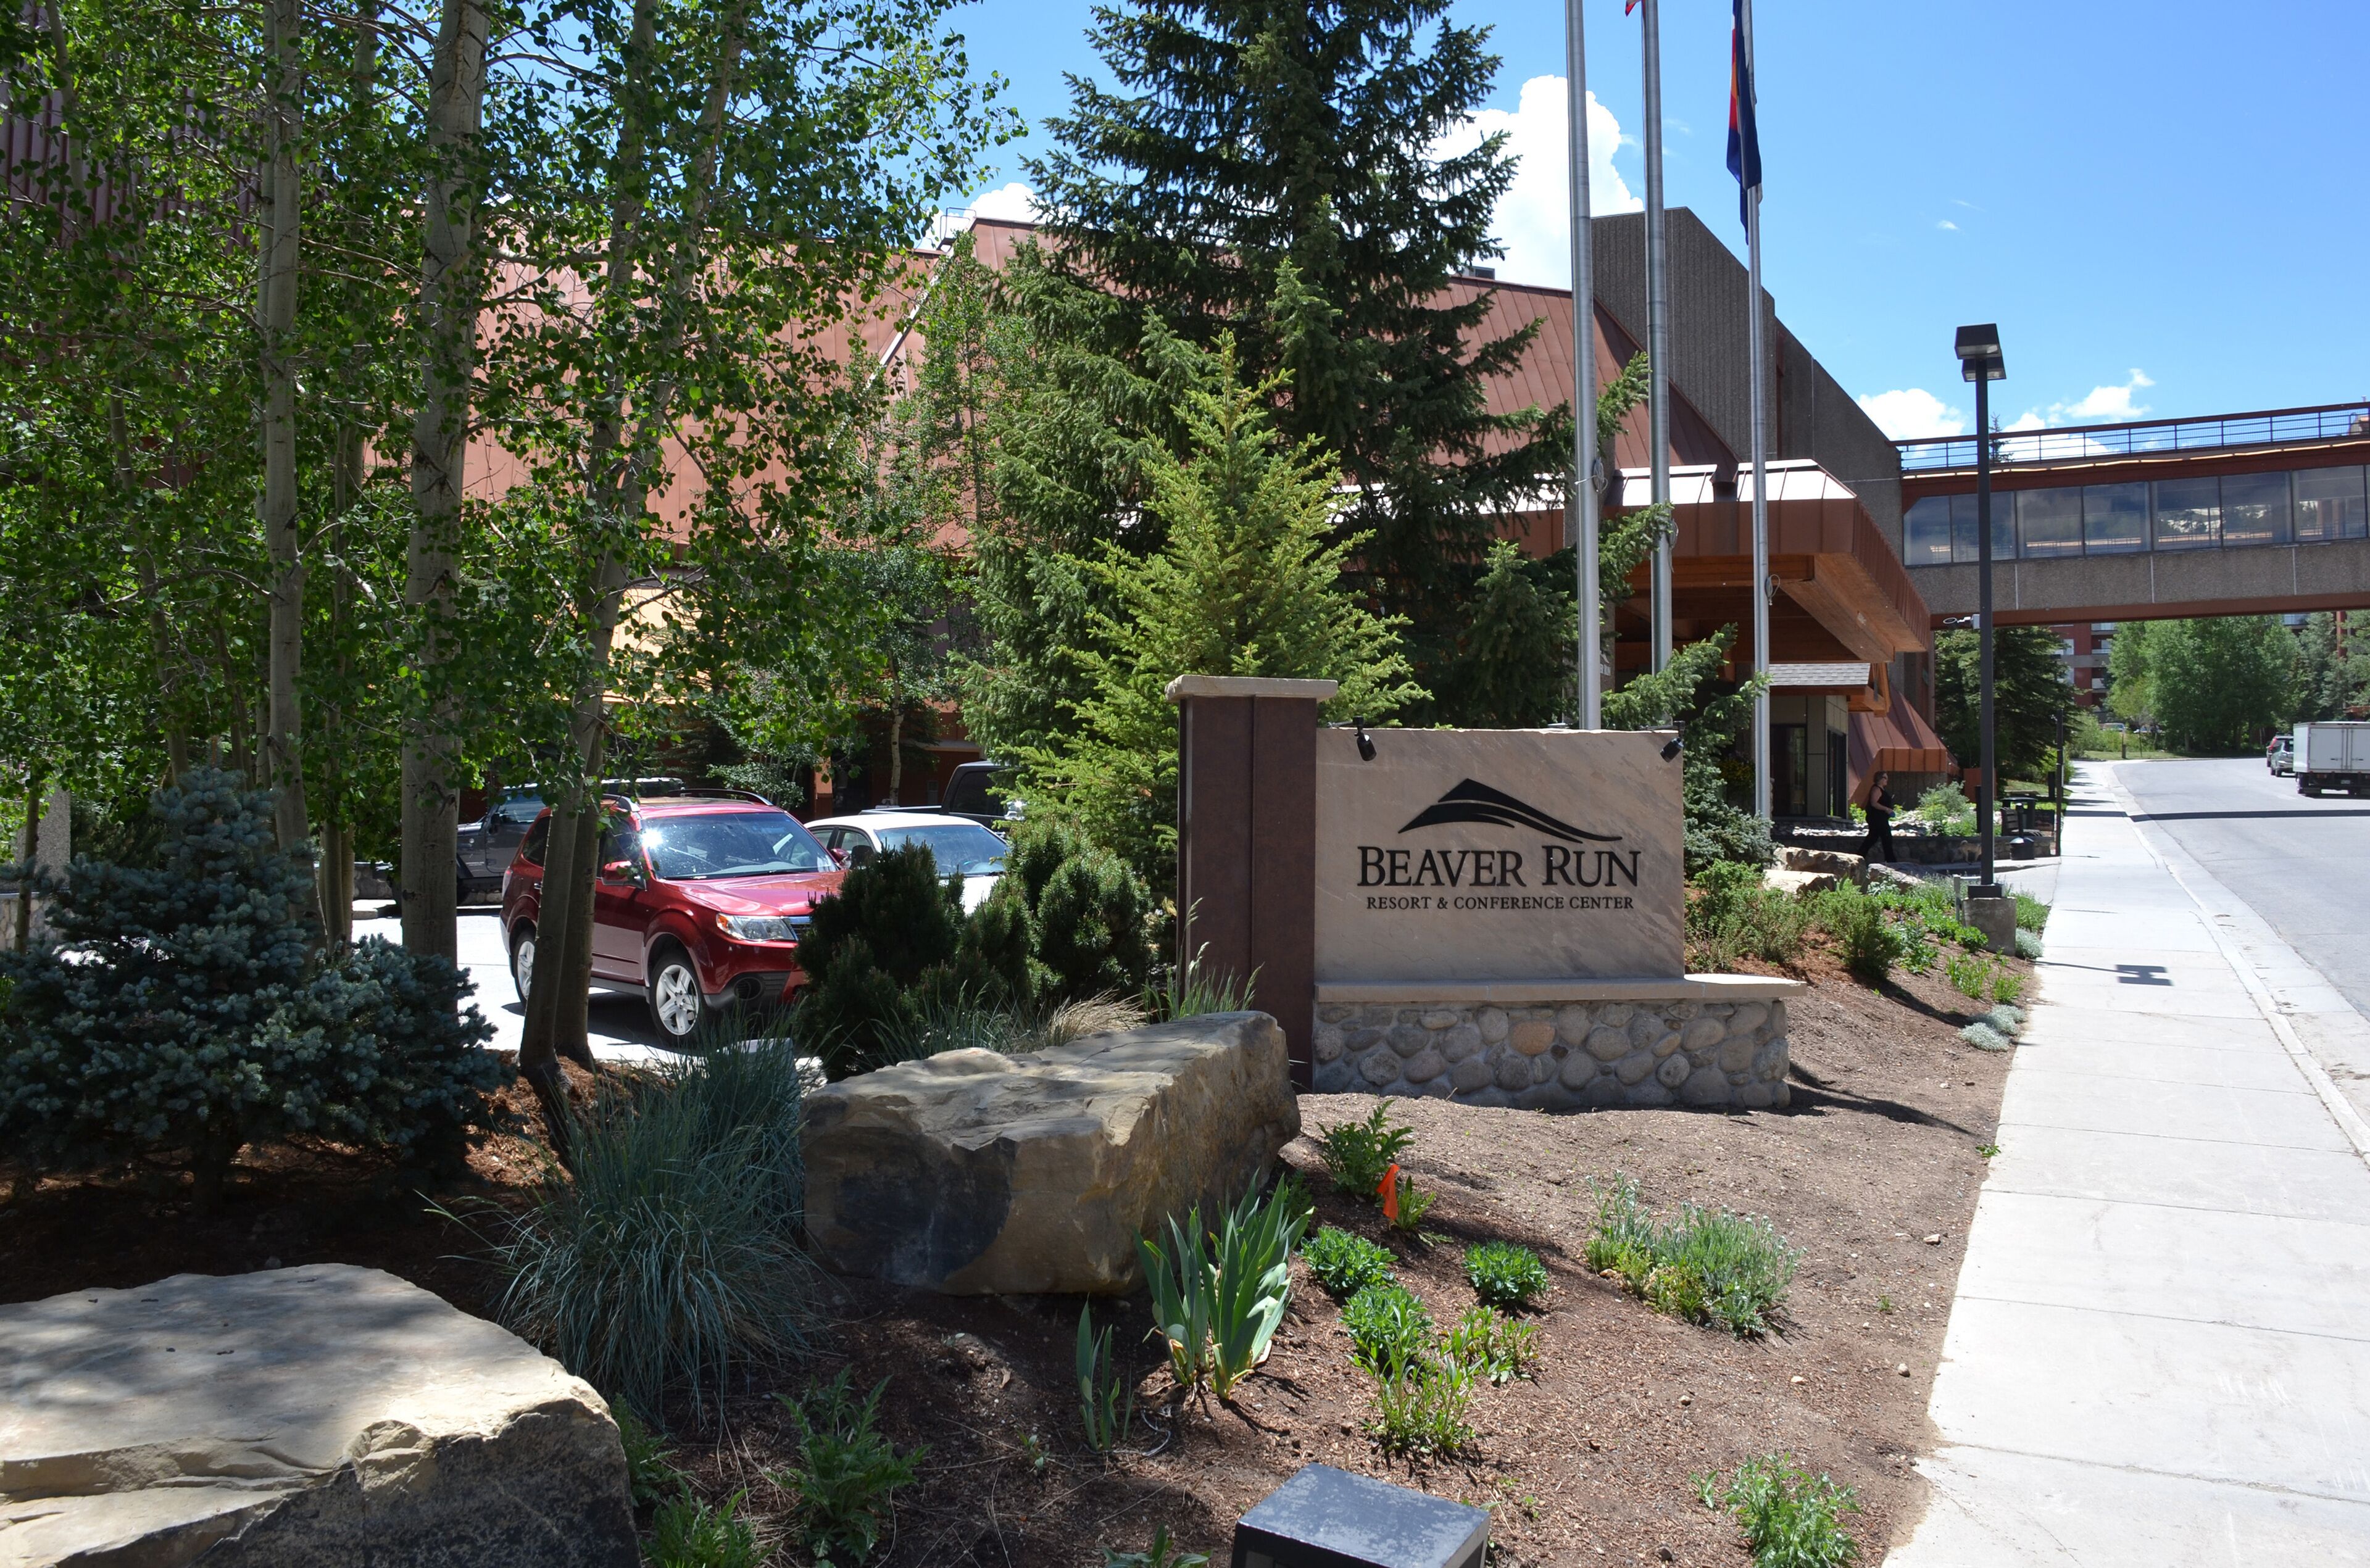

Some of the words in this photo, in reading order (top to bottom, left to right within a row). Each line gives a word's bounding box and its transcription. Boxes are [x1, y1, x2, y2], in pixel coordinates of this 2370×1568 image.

[1357, 846, 1527, 887] BEAVER
[1541, 845, 1642, 887] RUN
[1366, 897, 1432, 910] RESORT
[1437, 897, 1449, 910] &
[1453, 897, 1564, 910] CONFERENCE
[1569, 896, 1634, 910] CENTER
